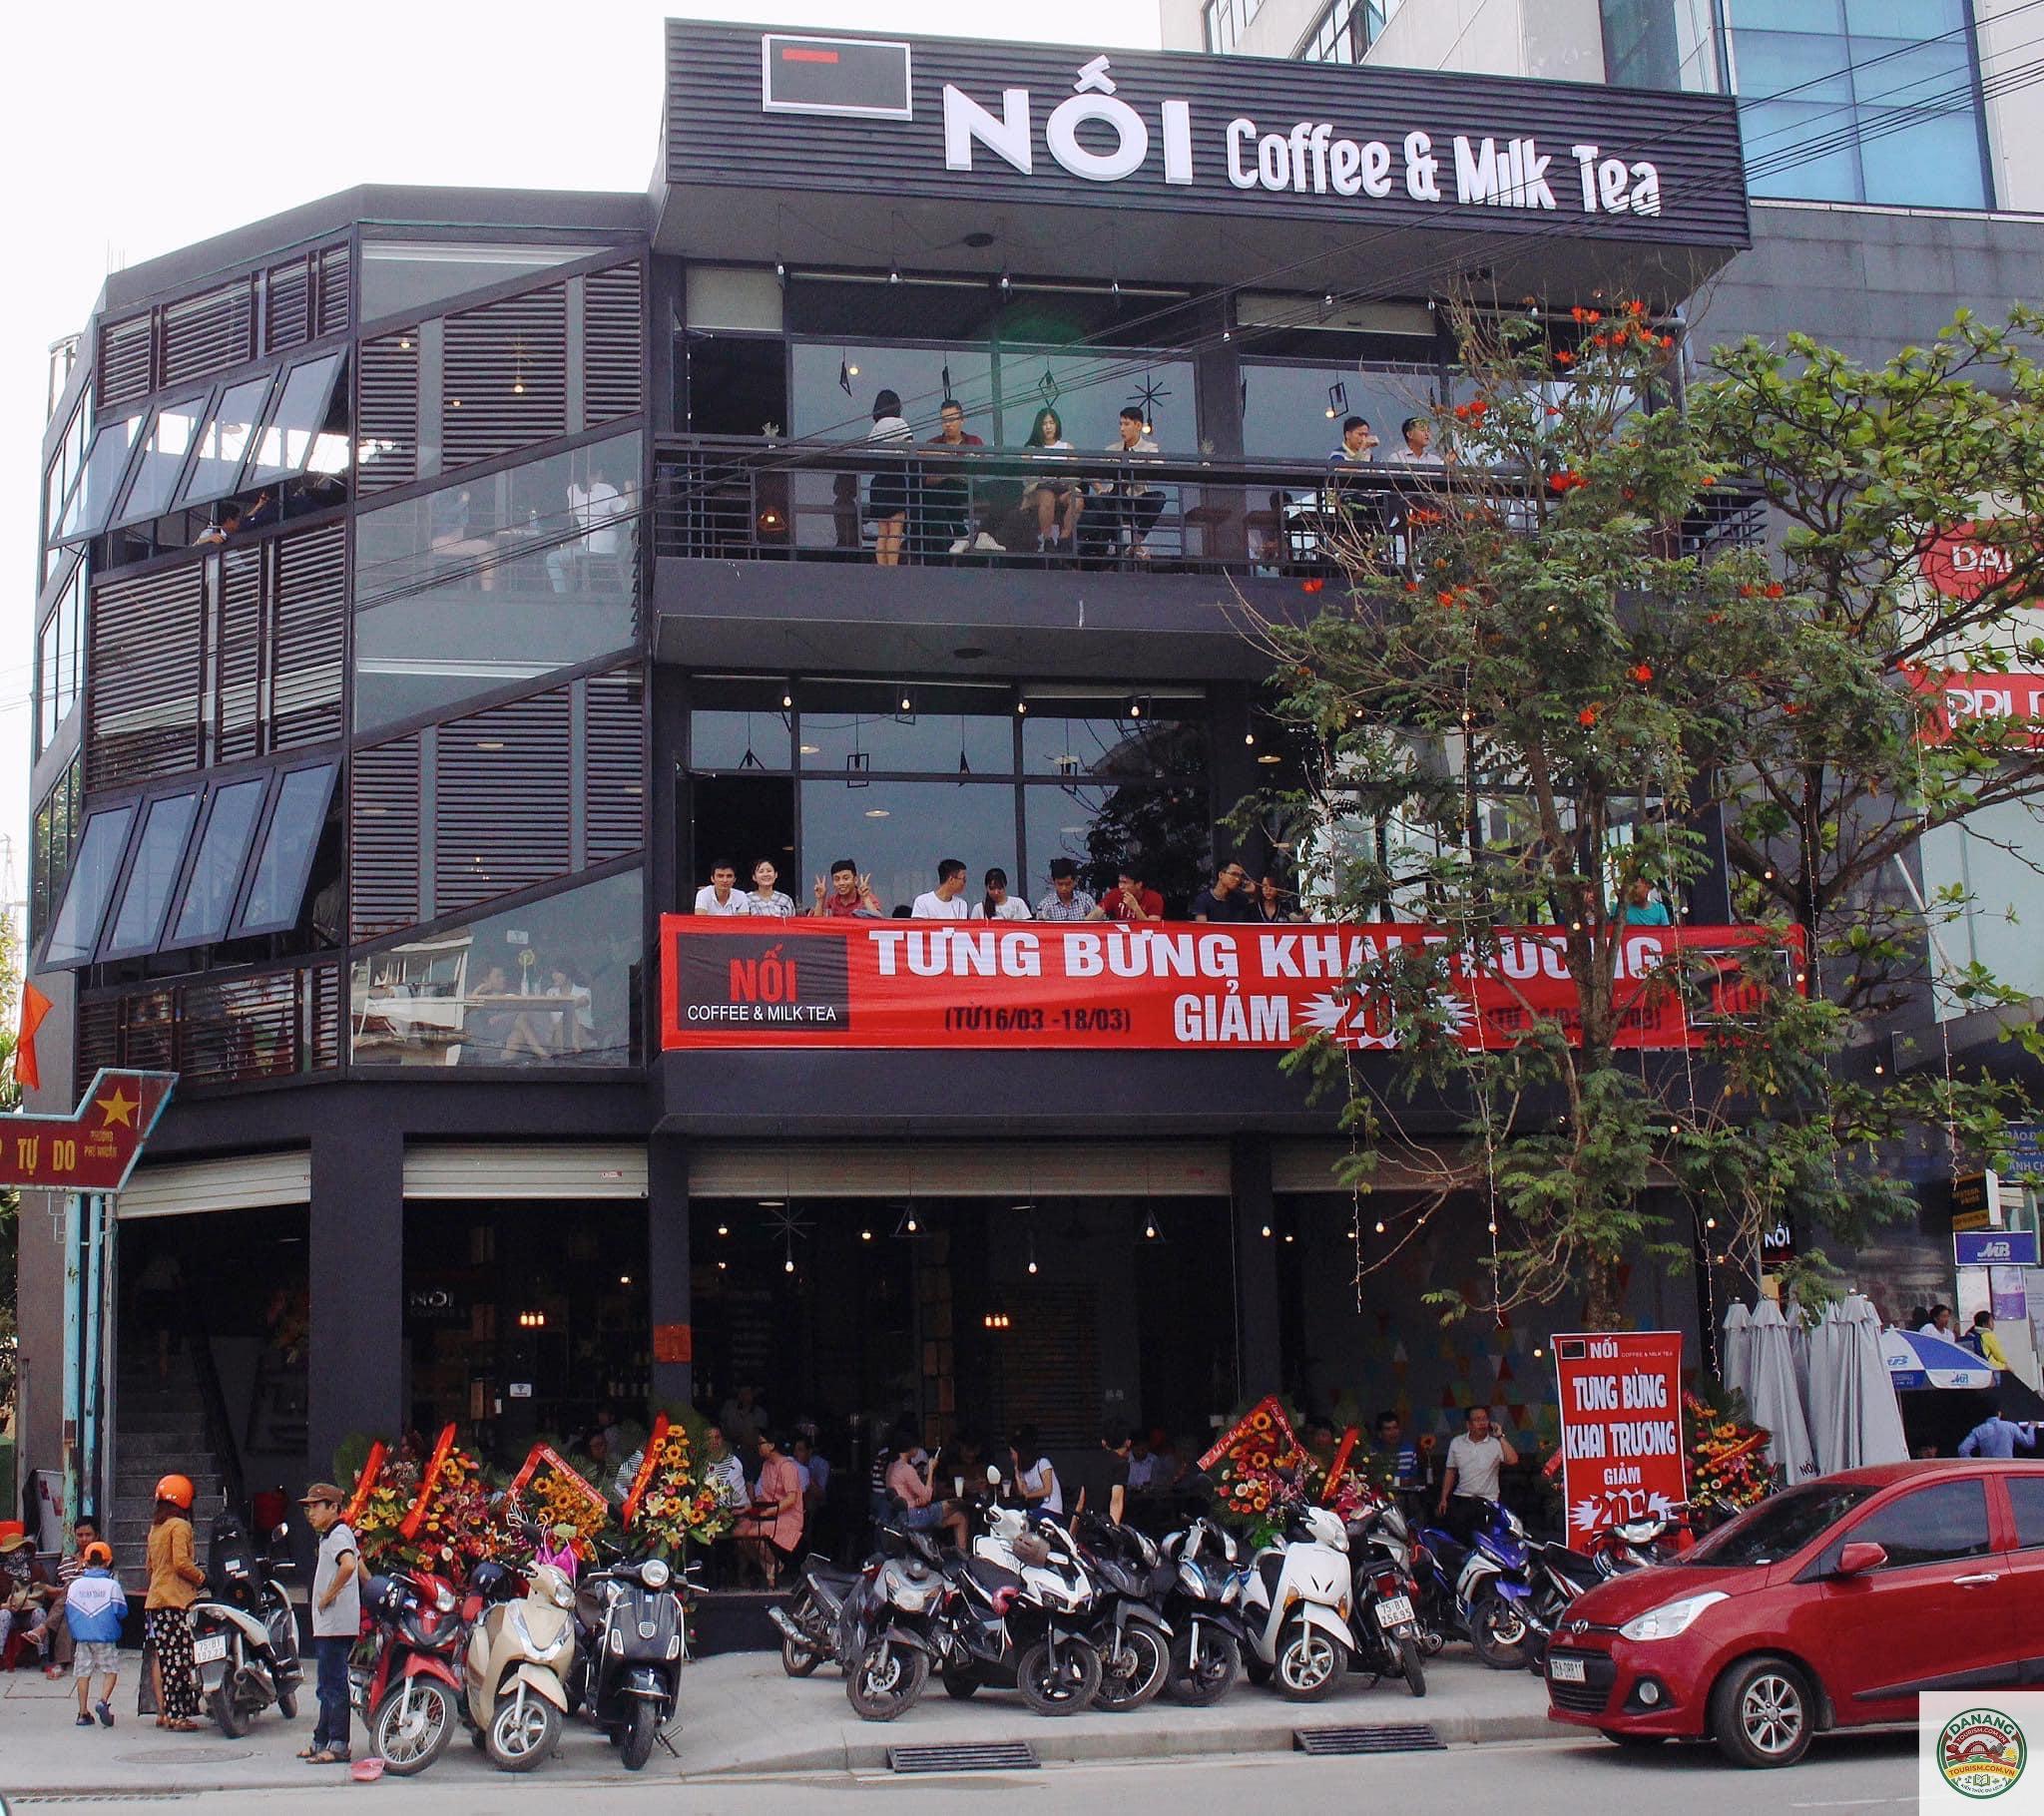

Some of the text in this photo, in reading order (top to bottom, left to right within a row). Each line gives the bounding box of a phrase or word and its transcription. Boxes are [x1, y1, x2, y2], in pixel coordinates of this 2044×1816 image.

[943, 54, 1662, 219] NỐI Coffee & Milk Tea
[869, 929, 1041, 978] TƯNG
[1064, 924, 1241, 979] BỪNG
[730, 943, 797, 1002] NỐI
[687, 1005, 836, 1021] COFFEE & MILK TEA
[1174, 982, 1289, 1042] GIẢM
[17, 1135, 39, 1175] TỰ
[53, 1139, 76, 1171] DO
[1590, 1336, 1618, 1359] NỐI
[1566, 1423, 1606, 1459] KHAI
[1604, 1462, 1641, 1486] GIẢM
